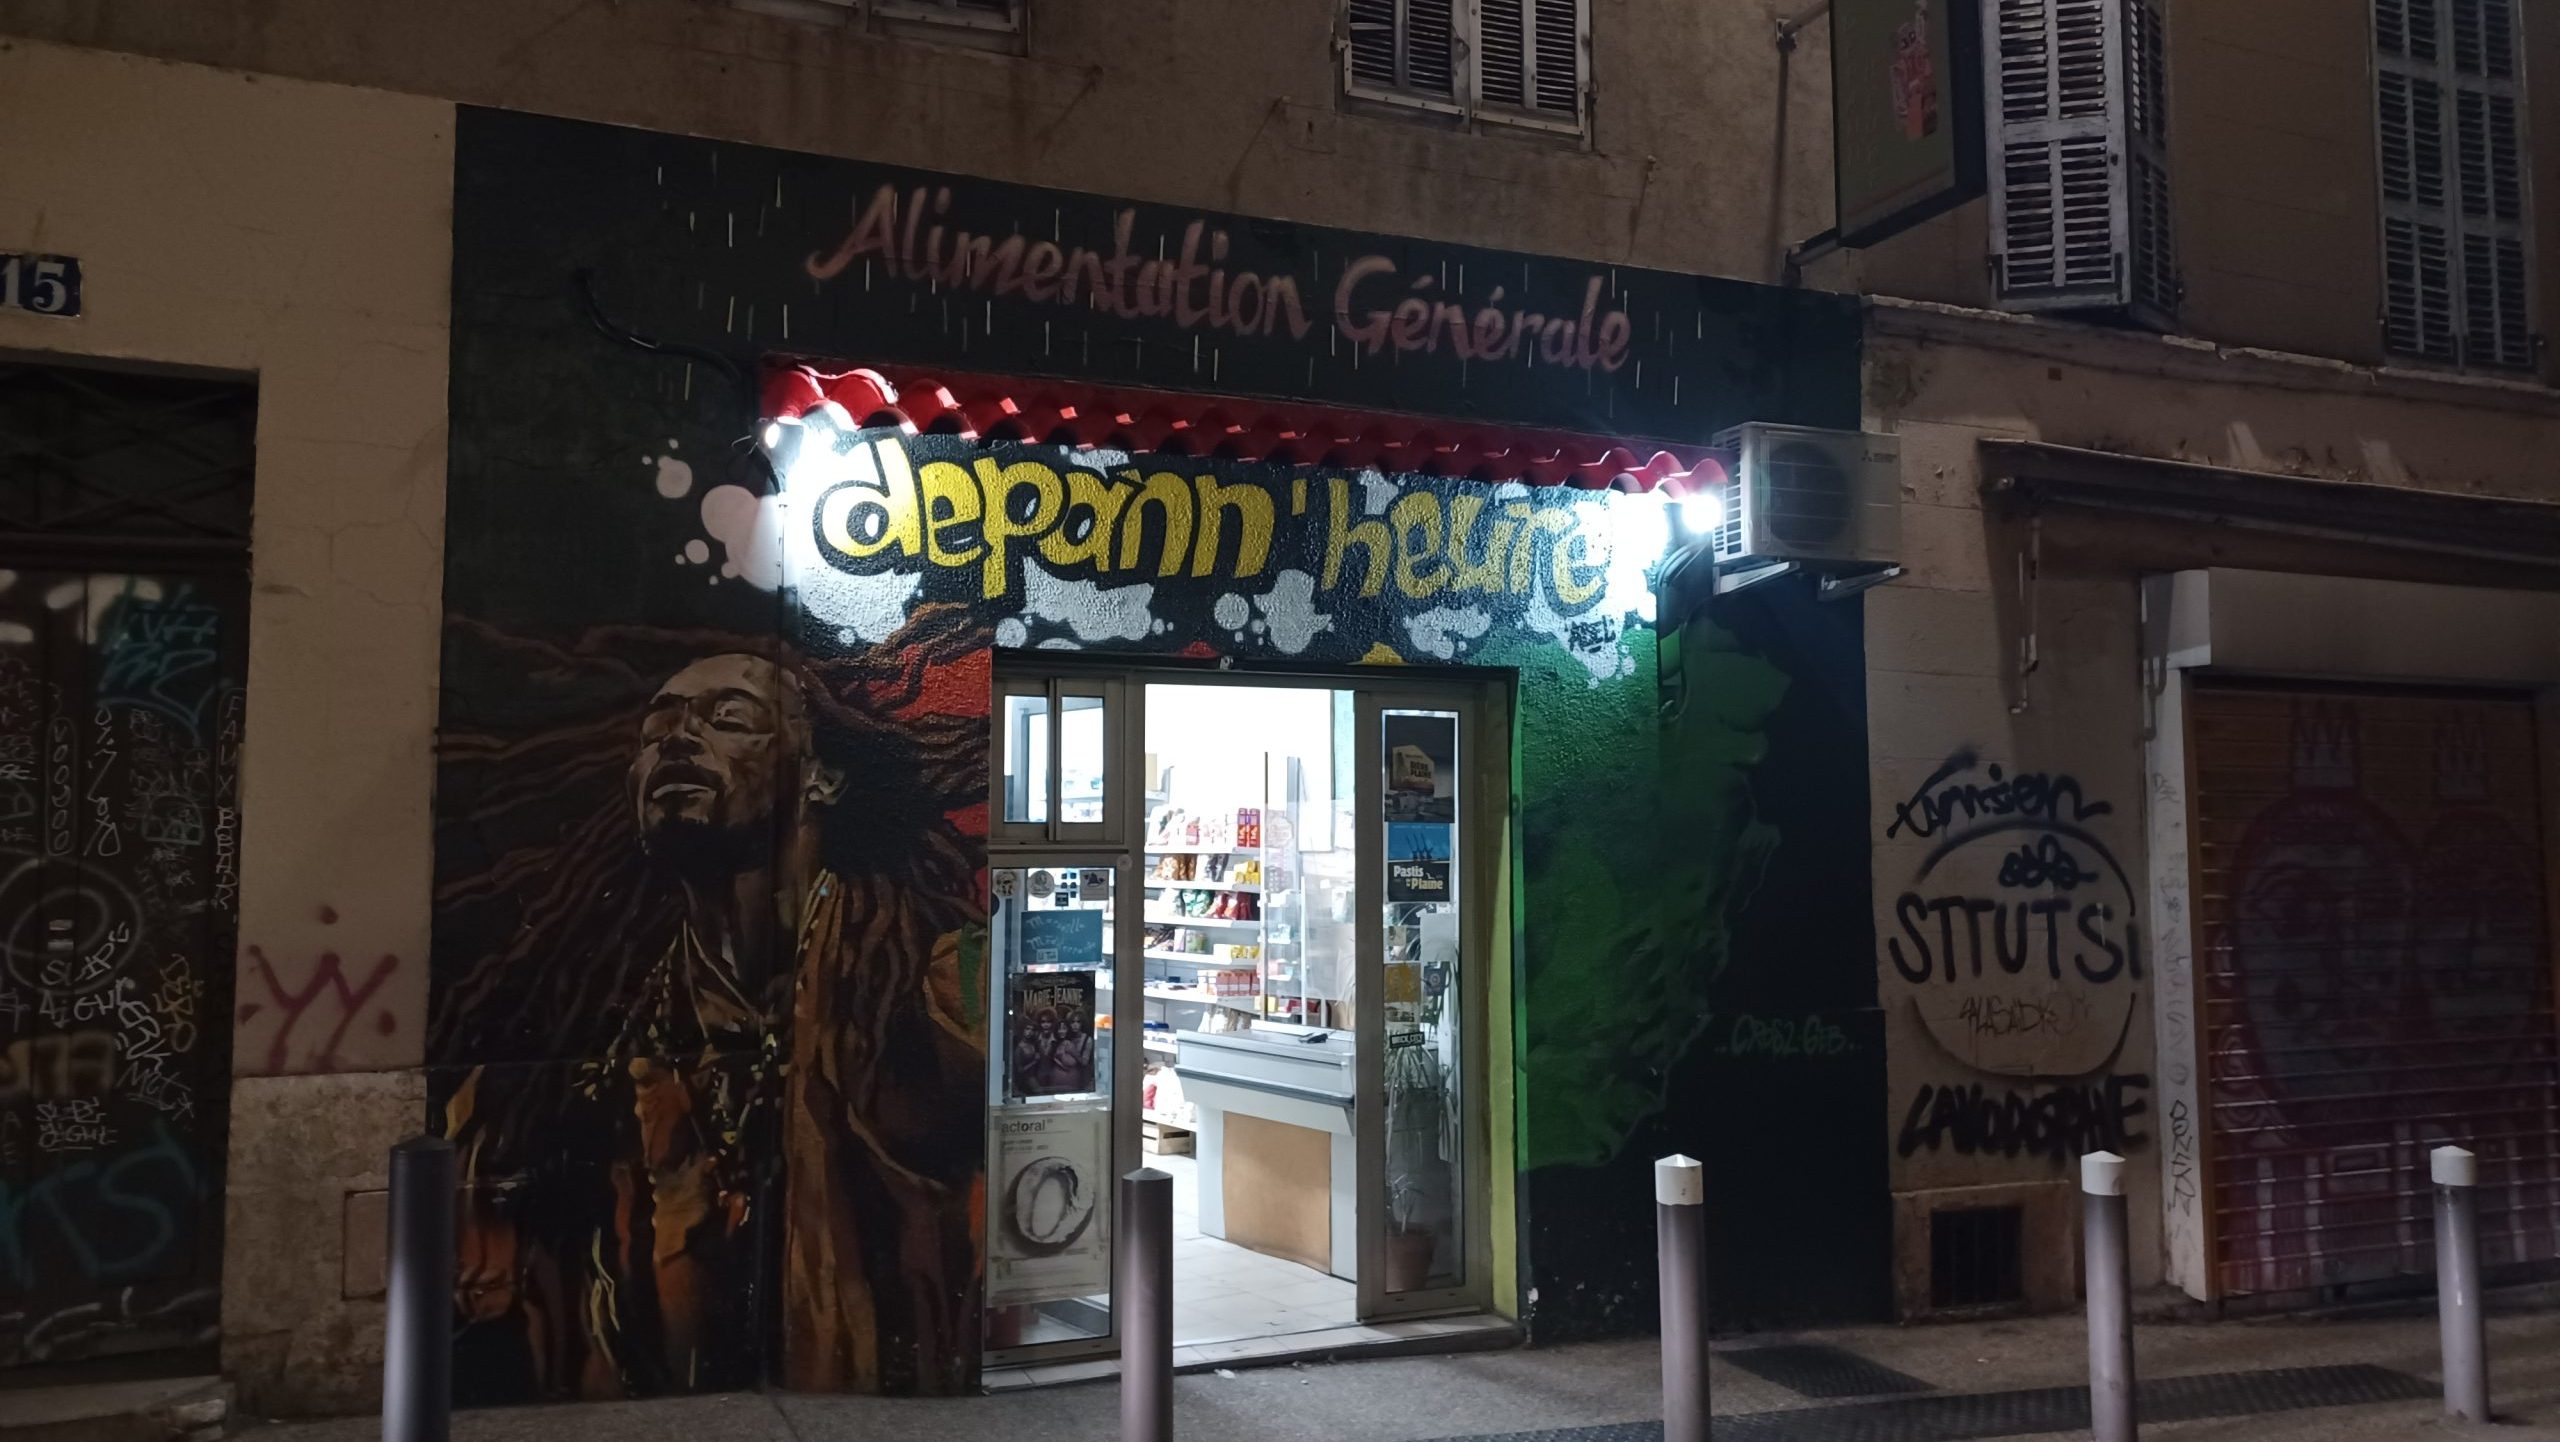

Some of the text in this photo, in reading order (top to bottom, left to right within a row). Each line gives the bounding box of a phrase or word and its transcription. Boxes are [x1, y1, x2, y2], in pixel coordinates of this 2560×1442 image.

[0, 261, 67, 314] 15
[806, 184, 1634, 373] Alimentation Générale
[1393, 865, 1424, 878] Pastis
